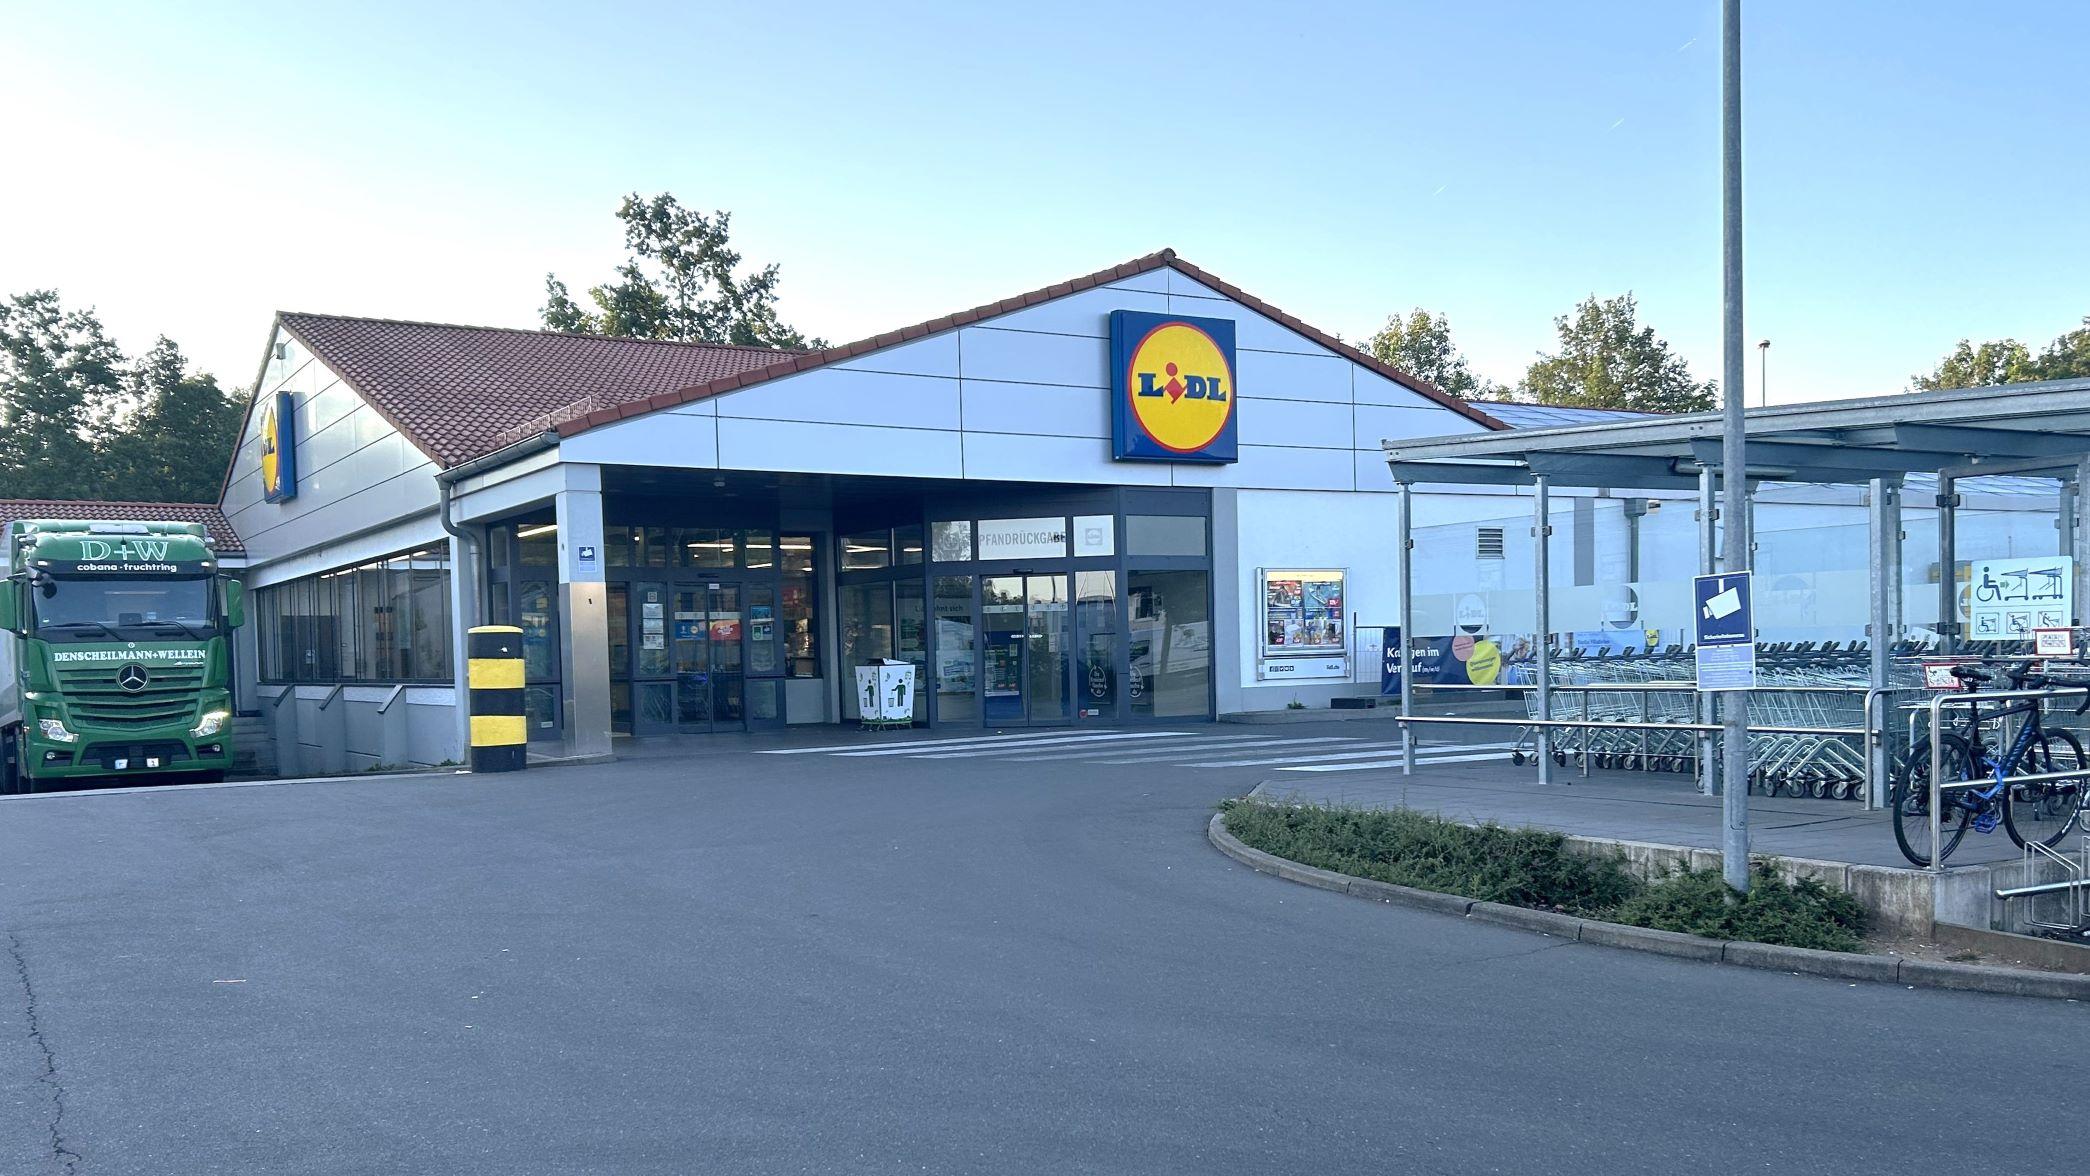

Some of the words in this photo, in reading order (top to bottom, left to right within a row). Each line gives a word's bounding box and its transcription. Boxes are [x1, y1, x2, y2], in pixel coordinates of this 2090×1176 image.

[1138, 362, 1227, 405] LIDL
[979, 530, 1066, 546] PFANDRÜCKGABE
[79, 540, 169, 561] D+W
[76, 563, 118, 571] cobana
[54, 650, 206, 662] DENSCHEILMANN+WELLEIN
[1427, 646, 1440, 657] im
[1386, 662, 1422, 673] Veruf
